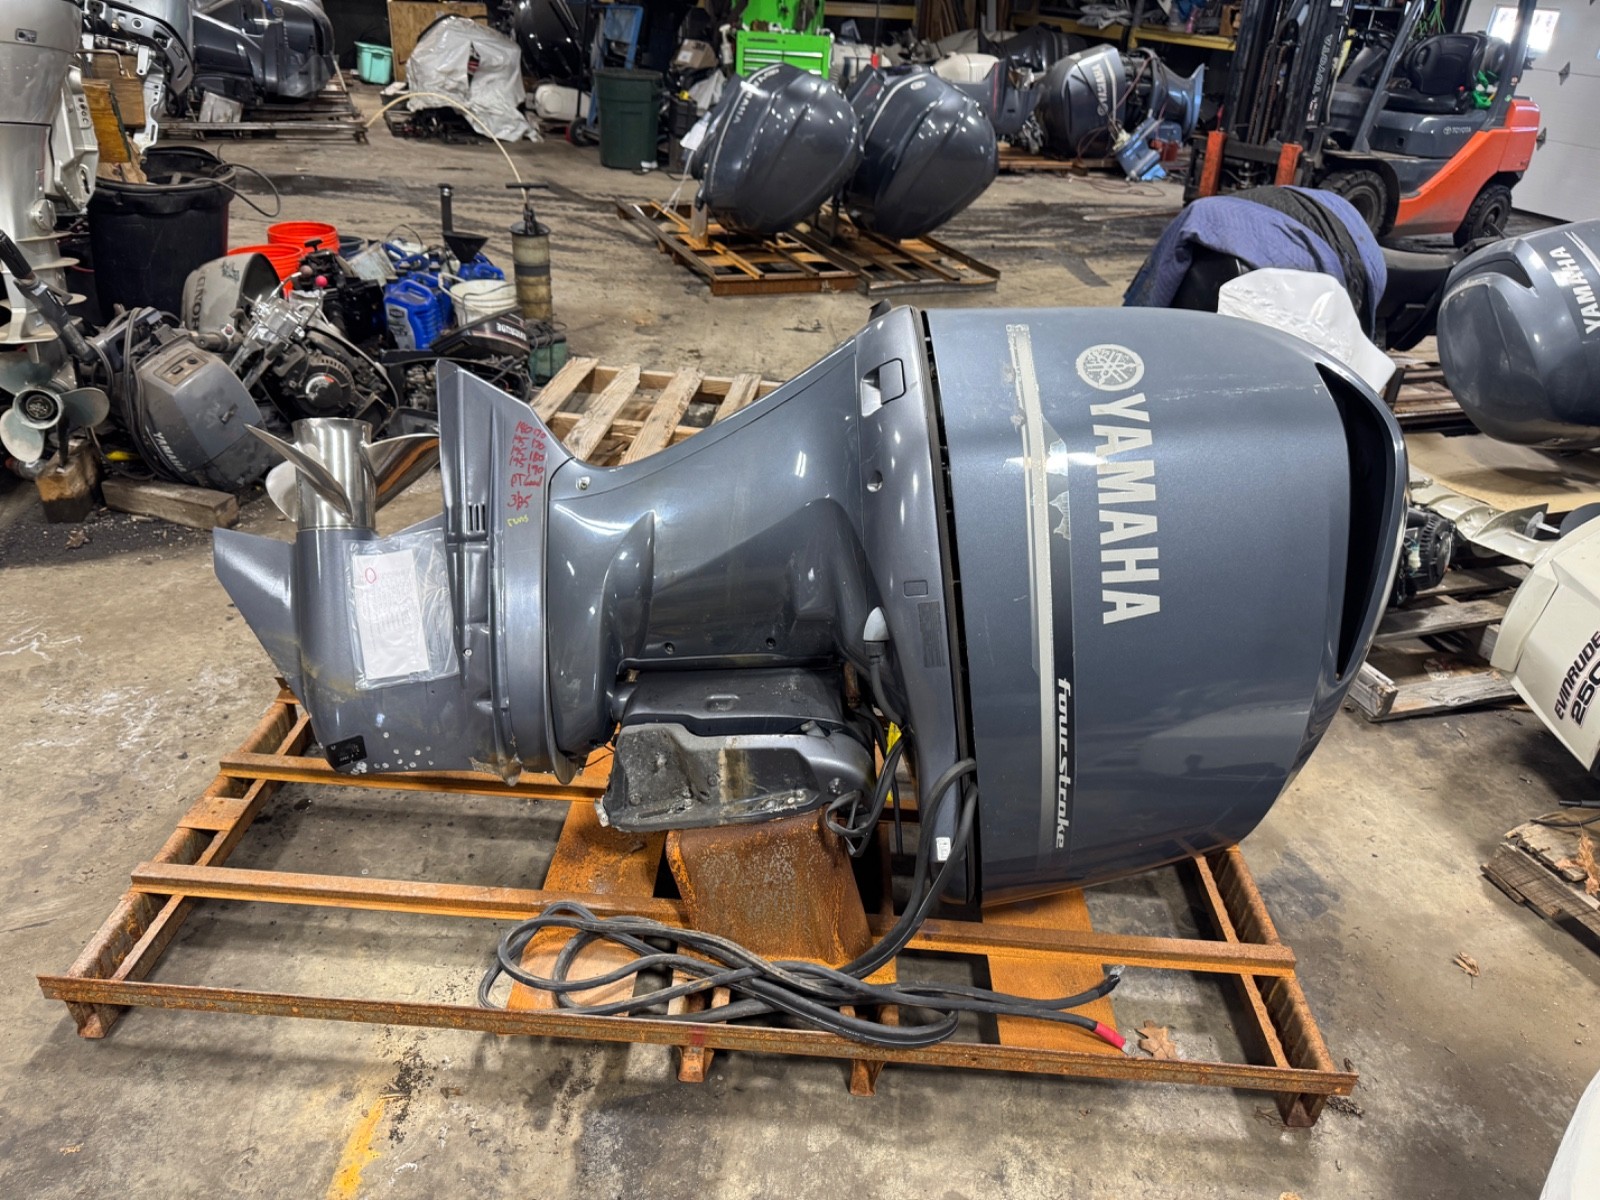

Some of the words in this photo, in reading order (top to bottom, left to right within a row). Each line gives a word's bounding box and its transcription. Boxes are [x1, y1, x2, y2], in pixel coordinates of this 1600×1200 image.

[1548, 245, 1600, 335] YAMAHA
[152, 431, 187, 472] YAMAHA
[1089, 392, 1161, 625] YAMAHA
[1554, 630, 1600, 721] EVINRUDE
[1055, 677, 1072, 849] fourstroke
